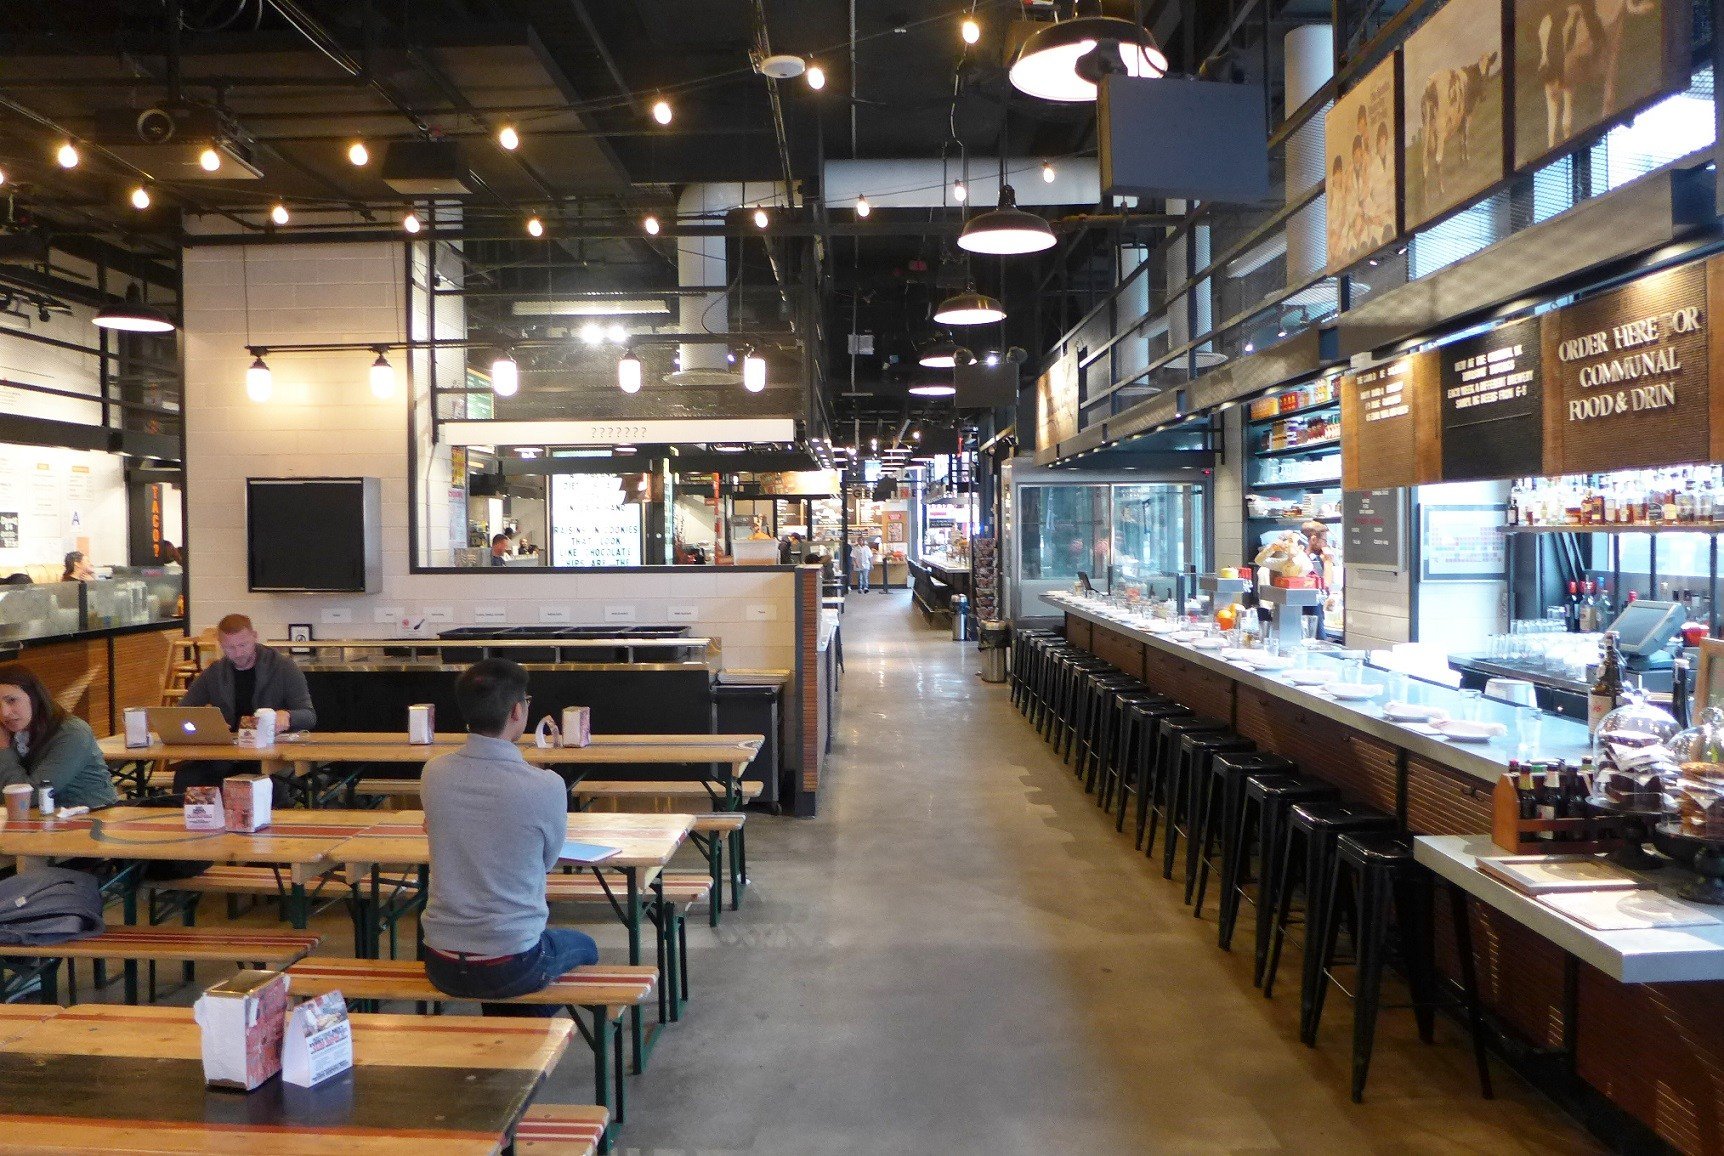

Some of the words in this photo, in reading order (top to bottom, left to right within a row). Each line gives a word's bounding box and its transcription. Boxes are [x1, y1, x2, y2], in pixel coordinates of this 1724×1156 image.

[1559, 331, 1609, 362] ORDER
[1613, 316, 1660, 349] HERE
[1580, 346, 1681, 388] COMMUNAL
[1569, 394, 1613, 421] FOOD
[1615, 391, 1628, 413] &
[72, 511, 80, 525] A
[586, 547, 632, 557] HOCOLATE
